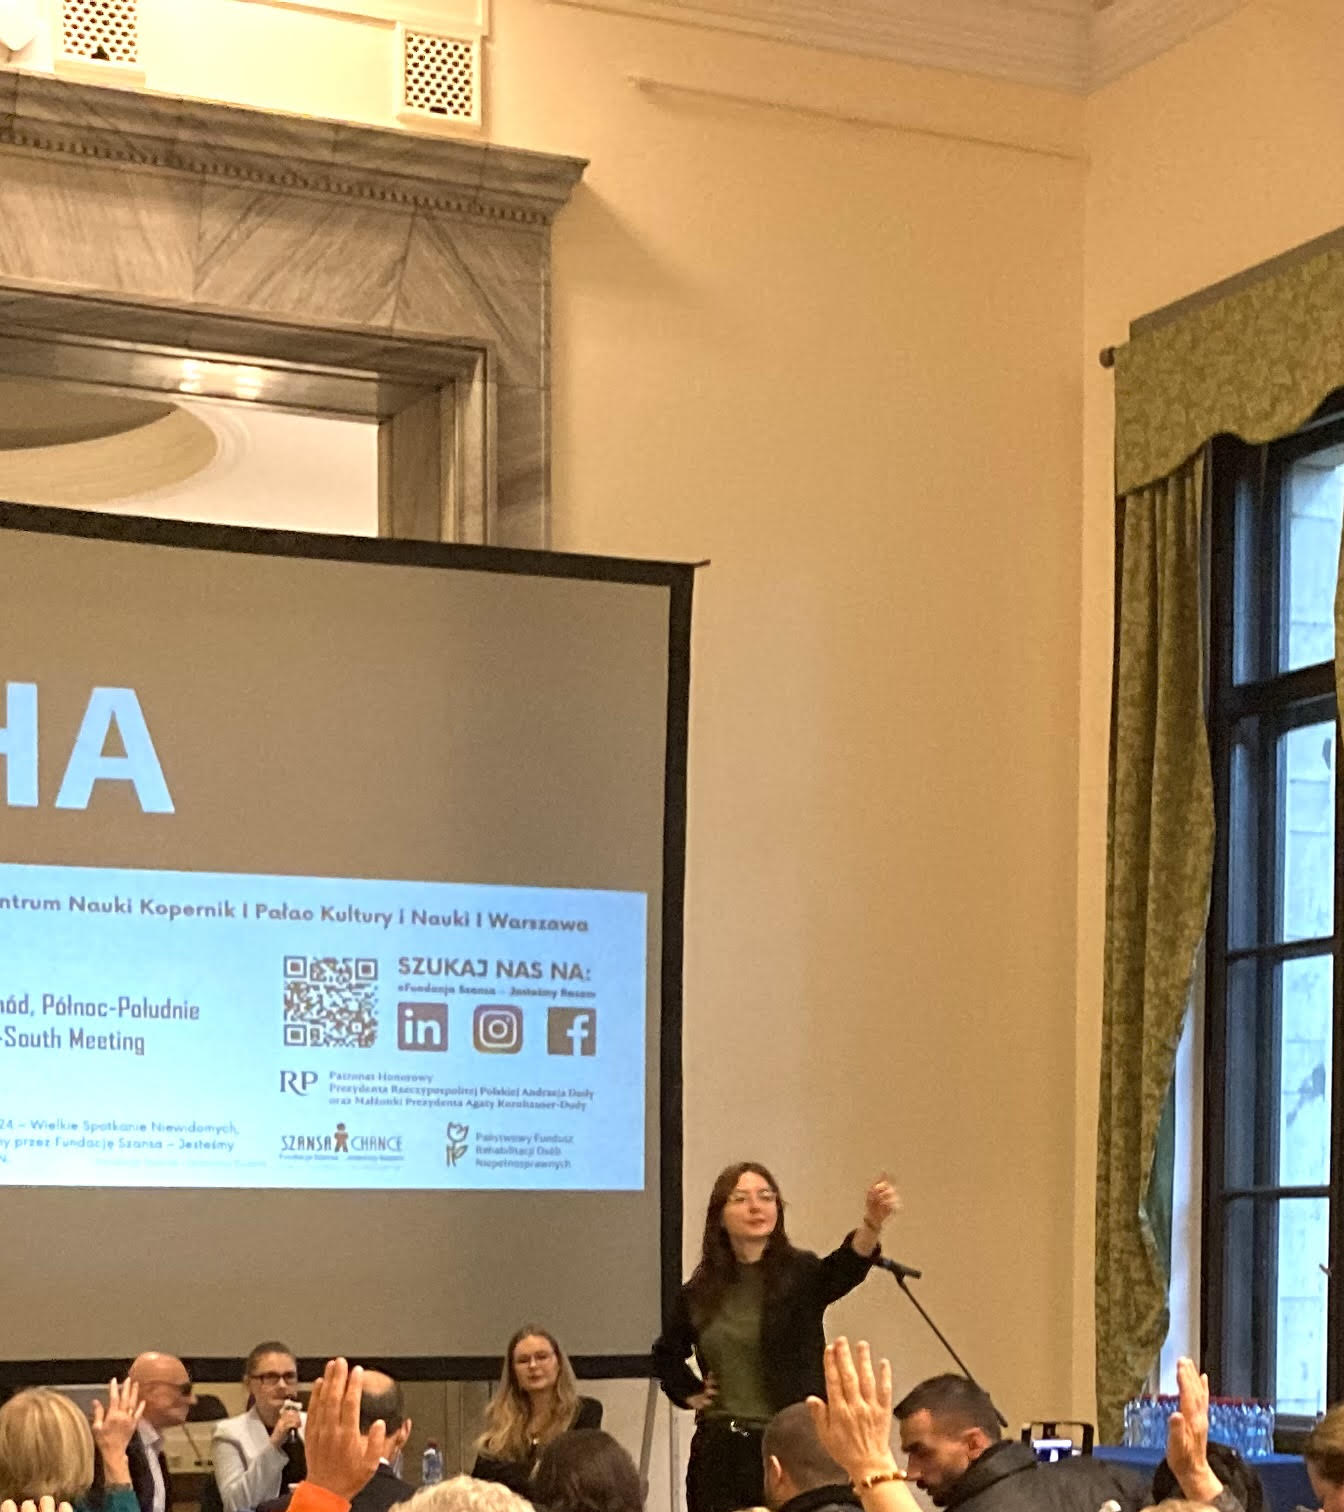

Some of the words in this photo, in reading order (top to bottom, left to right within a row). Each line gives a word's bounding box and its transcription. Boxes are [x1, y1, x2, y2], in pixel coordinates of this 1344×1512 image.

[69, 896, 132, 914] Nauki
[140, 899, 235, 920] Kopernik
[321, 904, 392, 929] Kultury
[412, 909, 469, 928] Nauki
[488, 912, 589, 932] Warszawa
[398, 956, 488, 977] SZUKAJ
[496, 959, 543, 979] NAS
[551, 961, 591, 981] NA:
[42, 993, 200, 1020] Północ-Południe
[69, 1027, 145, 1056] Meeting
[280, 1070, 318, 1096] RP
[30, 1119, 78, 1132] Wielkie
[83, 1119, 147, 1133] Spotkanie
[15, 1138, 50, 1149] przez
[118, 1138, 163, 1149] Szansa
[179, 1139, 234, 1151] Jesteśmy
[281, 1135, 332, 1151] SZANSA
[351, 1135, 402, 1152] CHANCE
